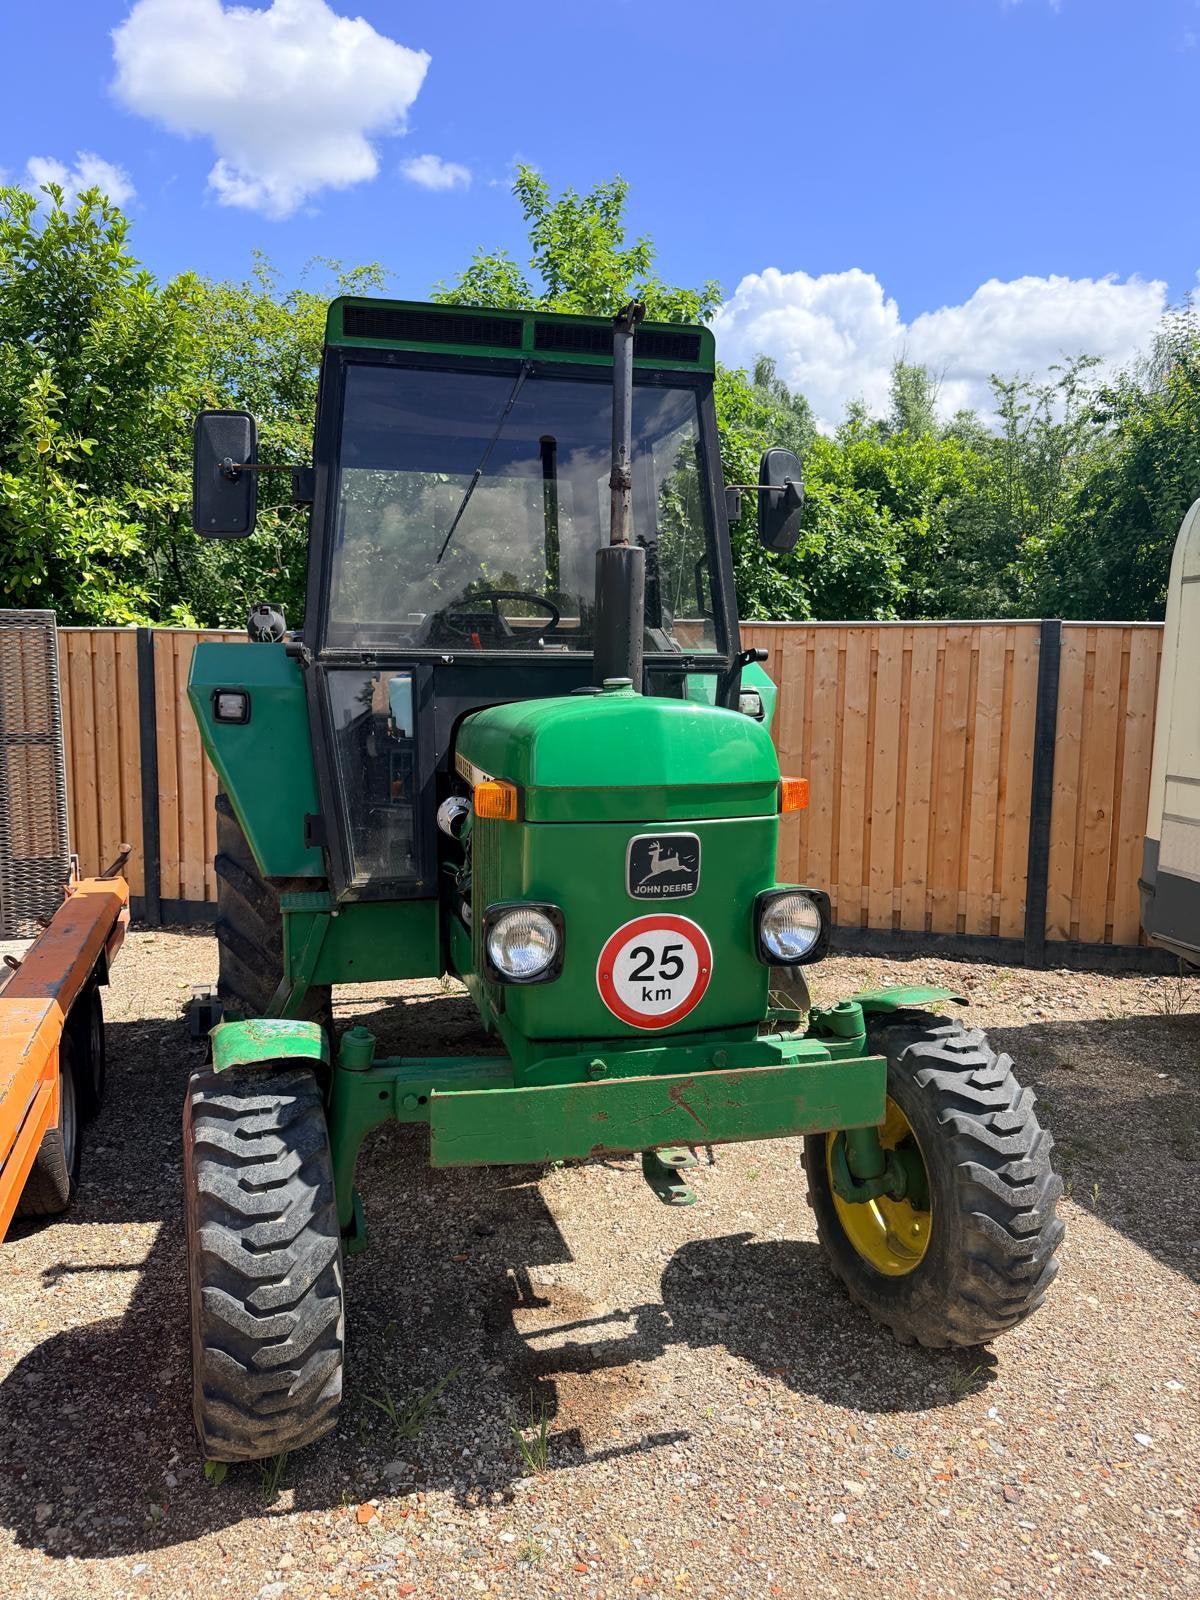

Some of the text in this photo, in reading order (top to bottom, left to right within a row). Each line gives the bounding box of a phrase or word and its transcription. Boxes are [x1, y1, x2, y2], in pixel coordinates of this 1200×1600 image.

[634, 883, 693, 894] JOHN DEERE
[628, 944, 684, 981] 25
[642, 986, 671, 1001] km
